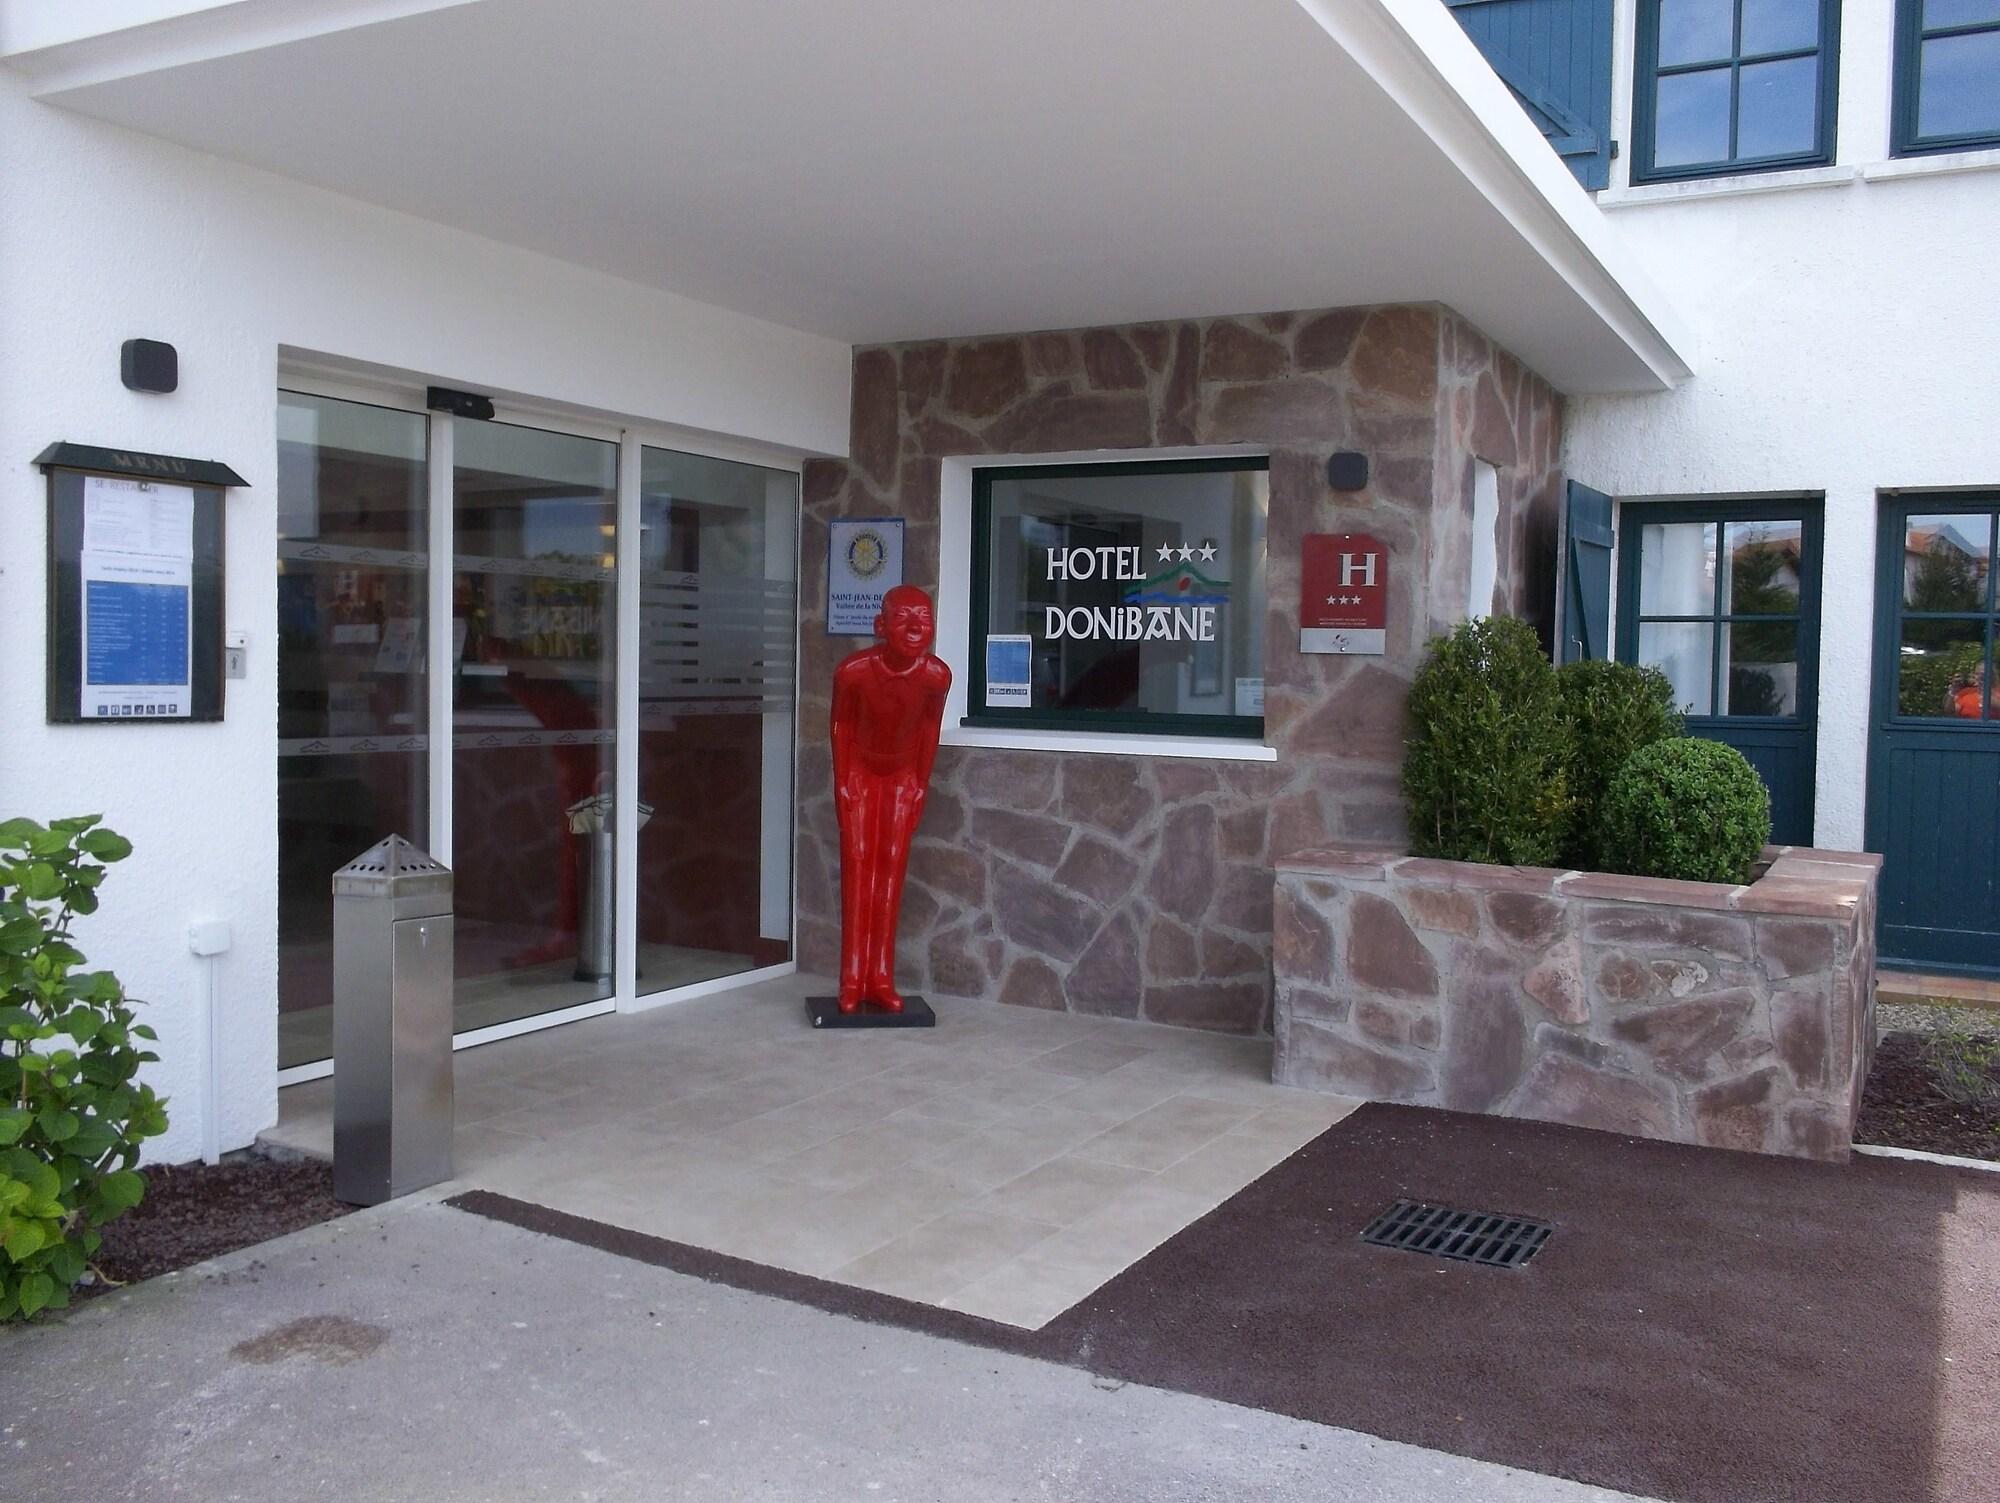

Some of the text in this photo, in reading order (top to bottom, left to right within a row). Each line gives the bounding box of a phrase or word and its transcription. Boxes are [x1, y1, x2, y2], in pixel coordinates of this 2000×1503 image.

[112, 453, 187, 474] MENU
[1046, 546, 1147, 581] HOTEL
[1338, 552, 1380, 588] H
